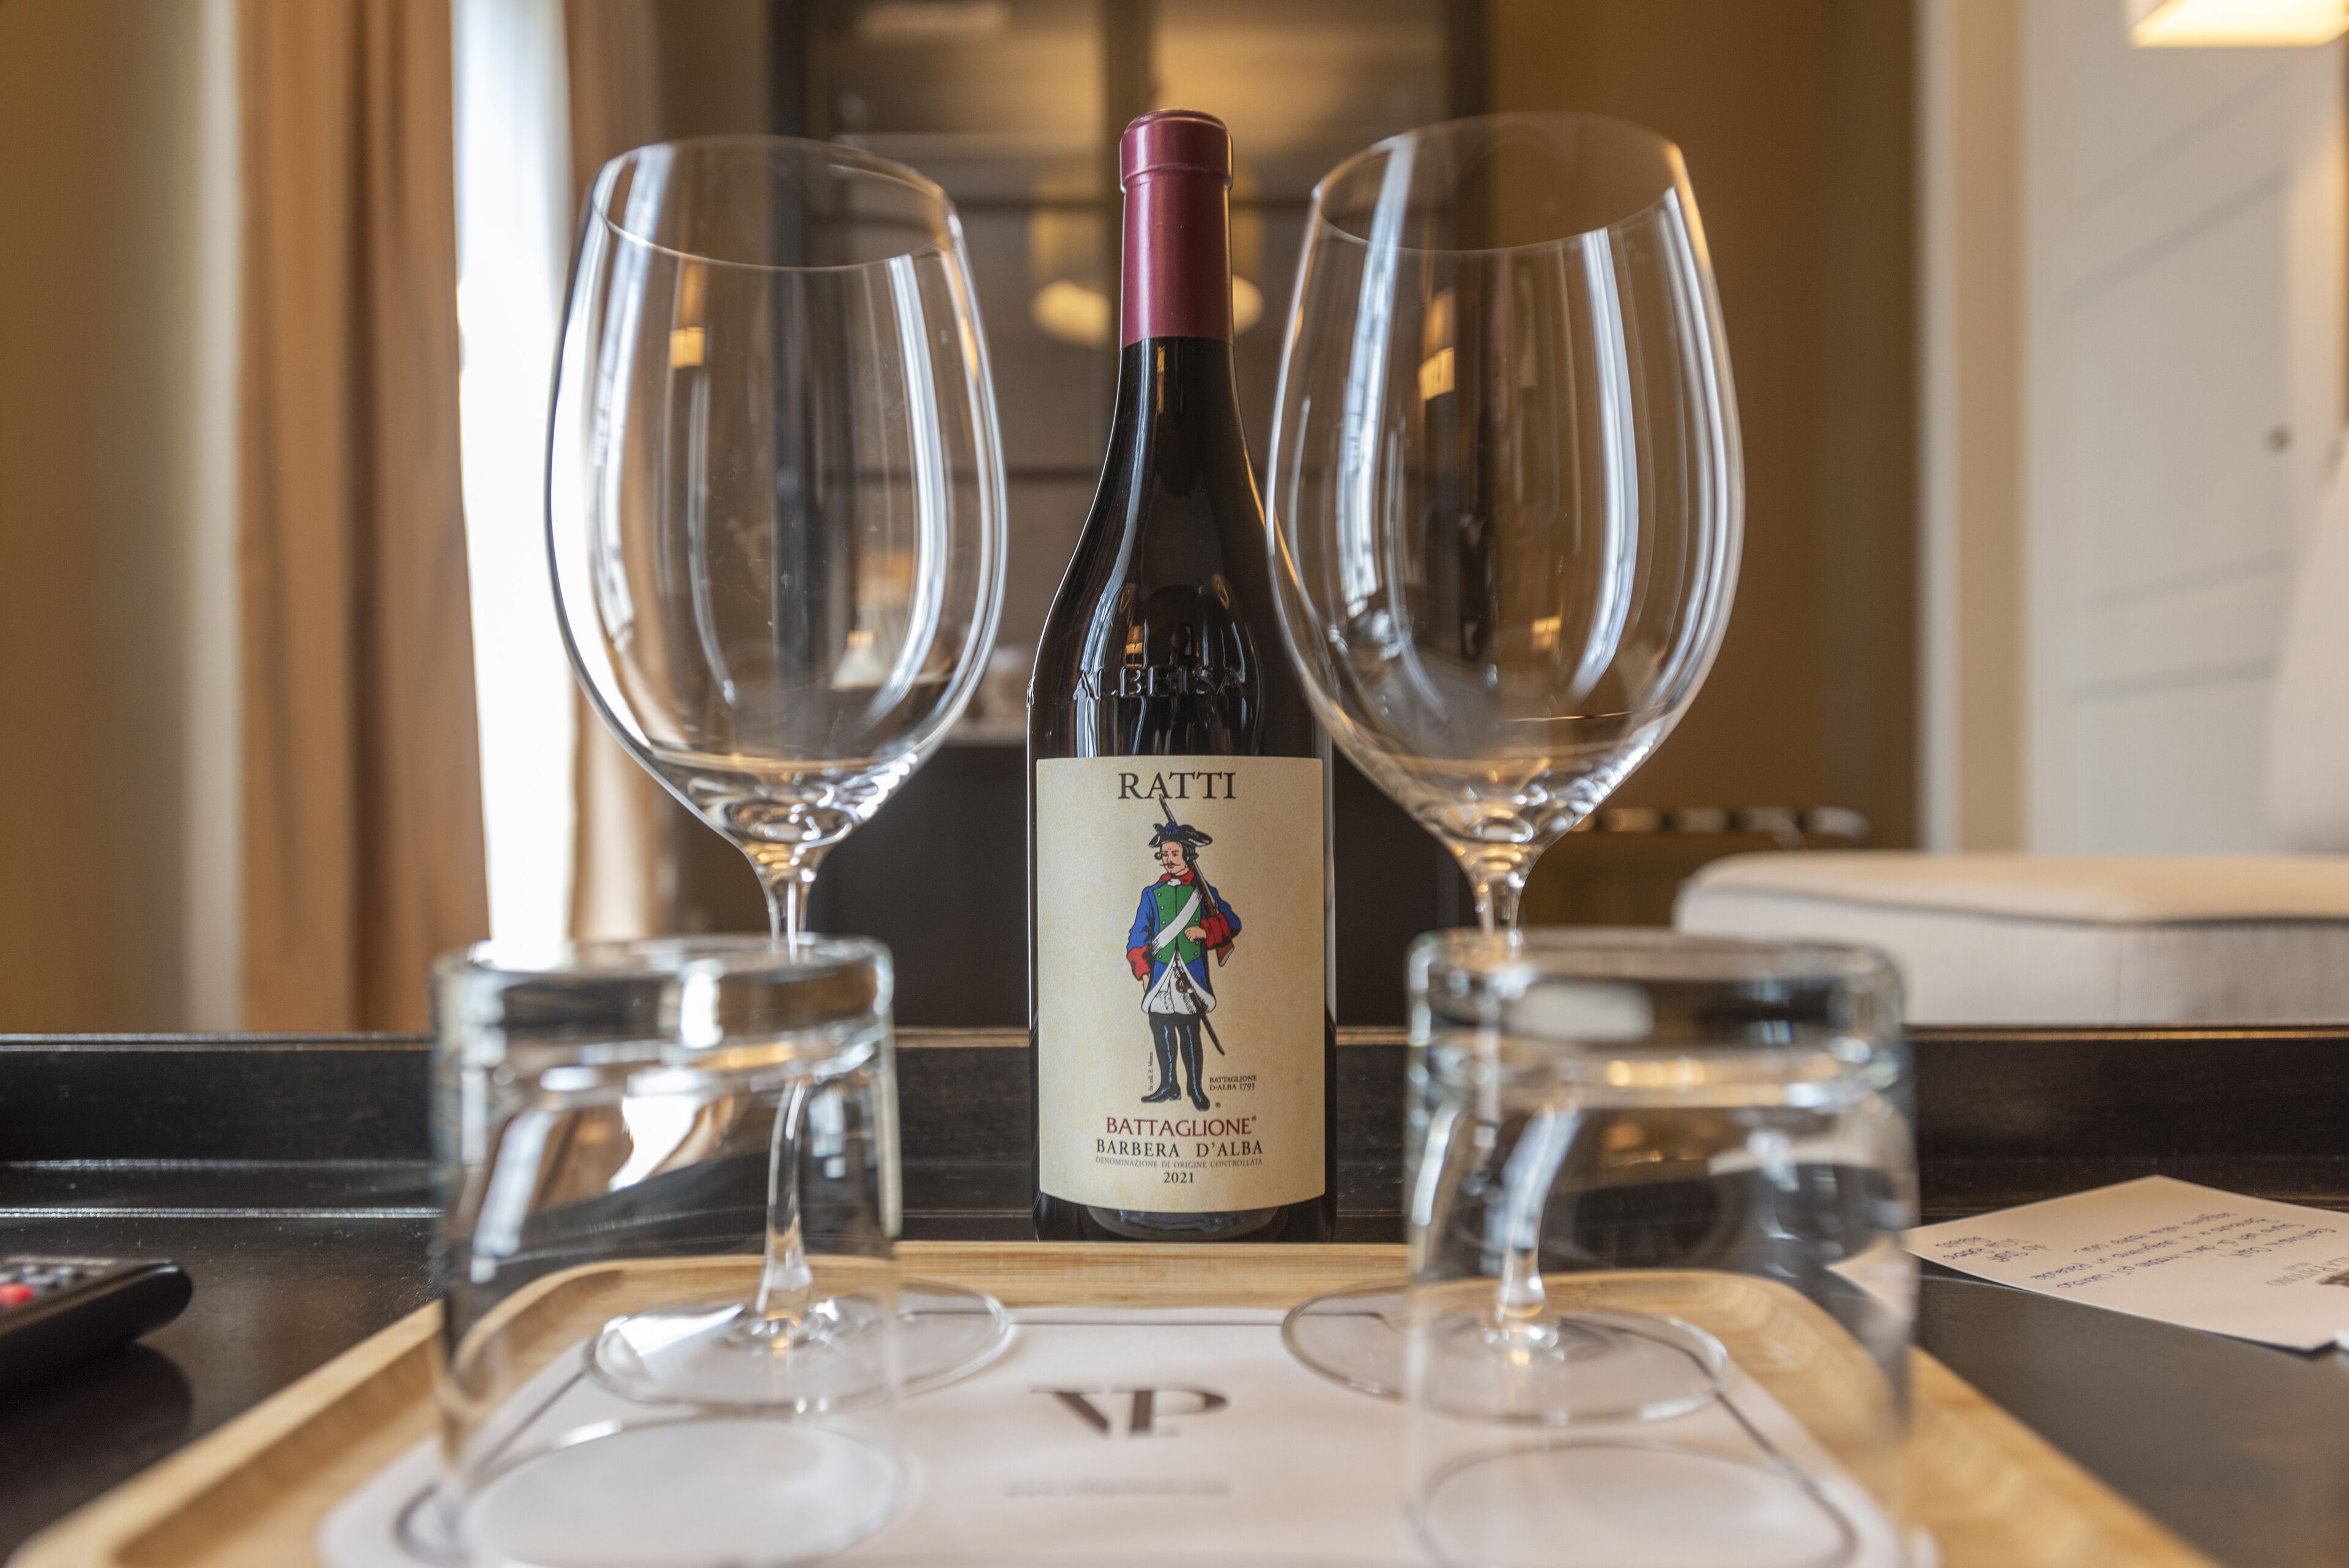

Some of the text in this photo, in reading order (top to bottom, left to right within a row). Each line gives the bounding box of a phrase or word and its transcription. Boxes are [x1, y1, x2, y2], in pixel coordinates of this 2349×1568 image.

[1118, 771, 1236, 800] RATTI
[1239, 1083, 1255, 1091] 1793
[1096, 1139, 1263, 1157] BARBERA D'ALBA
[1096, 1156, 1158, 1168] DENOMINAZIONE
[1210, 1157, 1263, 1168] CONTROLLATA
[1163, 1172, 1194, 1184] 2021
